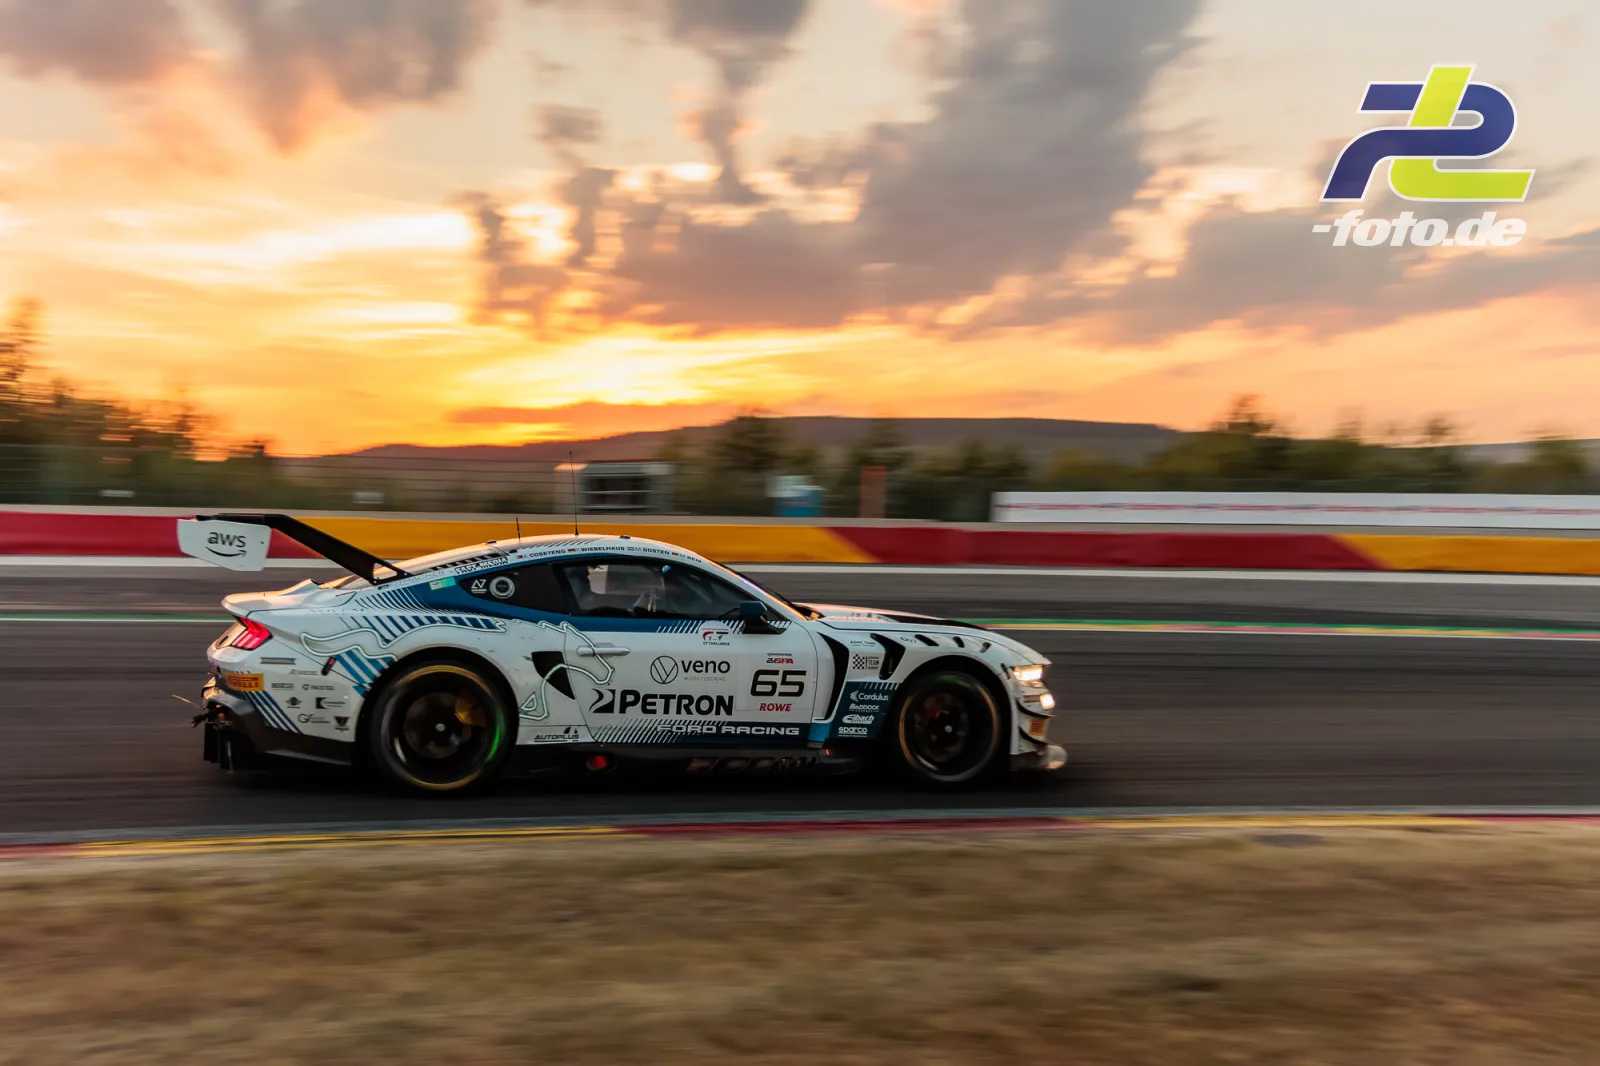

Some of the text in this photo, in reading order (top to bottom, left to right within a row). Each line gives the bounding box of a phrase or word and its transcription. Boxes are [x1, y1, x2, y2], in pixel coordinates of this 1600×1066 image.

[207, 531, 246, 548] aws
[529, 549, 566, 558] COSETENG
[681, 659, 730, 674] veno
[750, 669, 807, 697] 65
[858, 692, 889, 700] Cordulus
[619, 689, 734, 716] PETRON
[759, 702, 792, 712] ROWE
[842, 714, 875, 724] Eibach
[656, 724, 800, 735] FORD RACING
[838, 726, 868, 735] sparco
